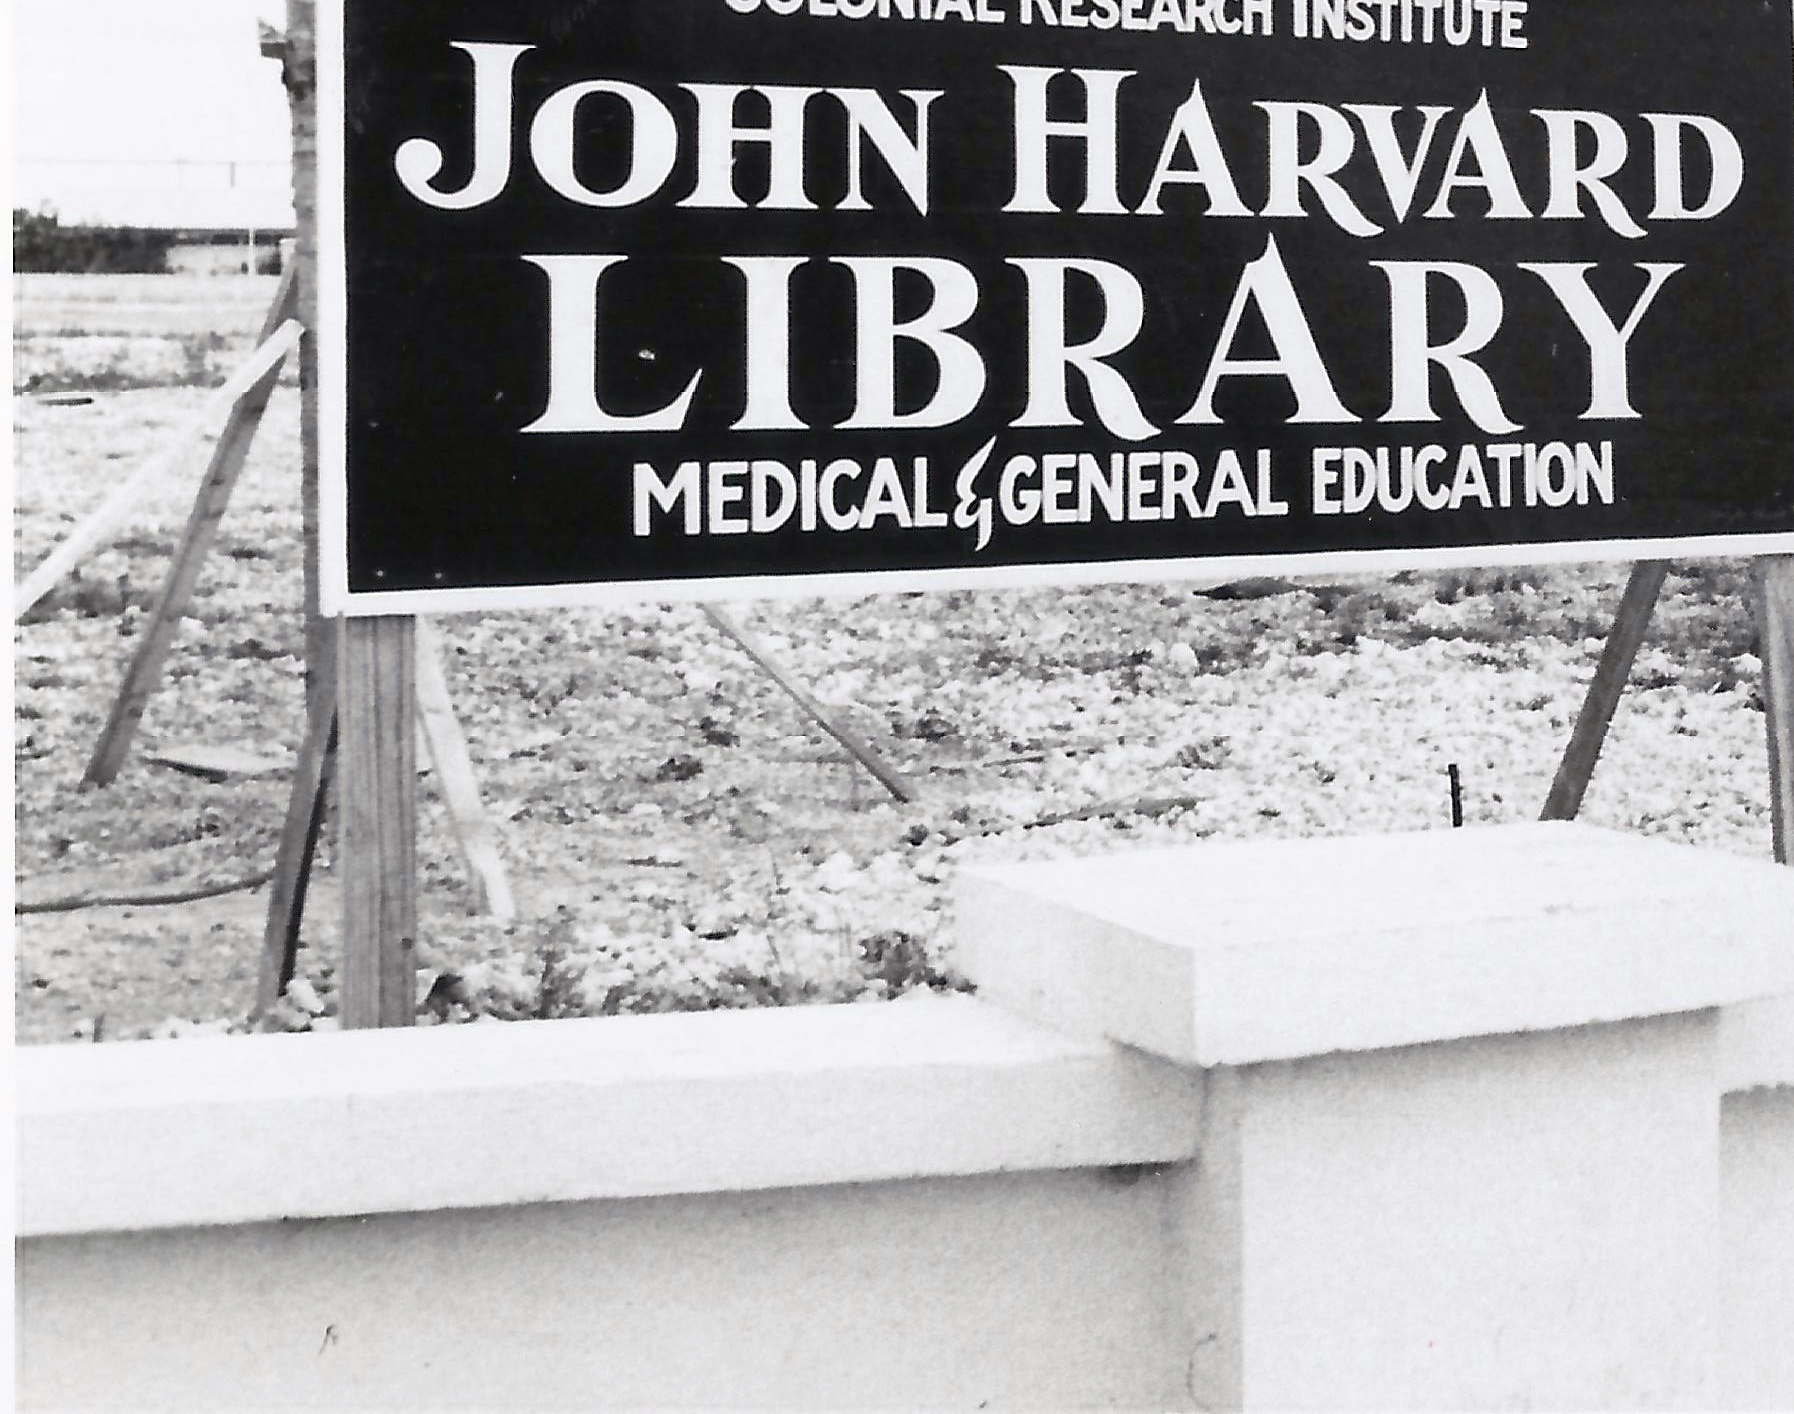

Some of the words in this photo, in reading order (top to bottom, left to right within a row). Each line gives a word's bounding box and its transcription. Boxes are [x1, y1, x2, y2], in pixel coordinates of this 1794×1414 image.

[394, 40, 945, 218] JOHN
[996, 63, 1746, 239] HARVARD
[519, 231, 1687, 443] LIBRARY
[633, 456, 950, 537] MEDICAL
[998, 448, 1290, 526] GENERAL
[1312, 439, 1616, 516] EDUCATION
